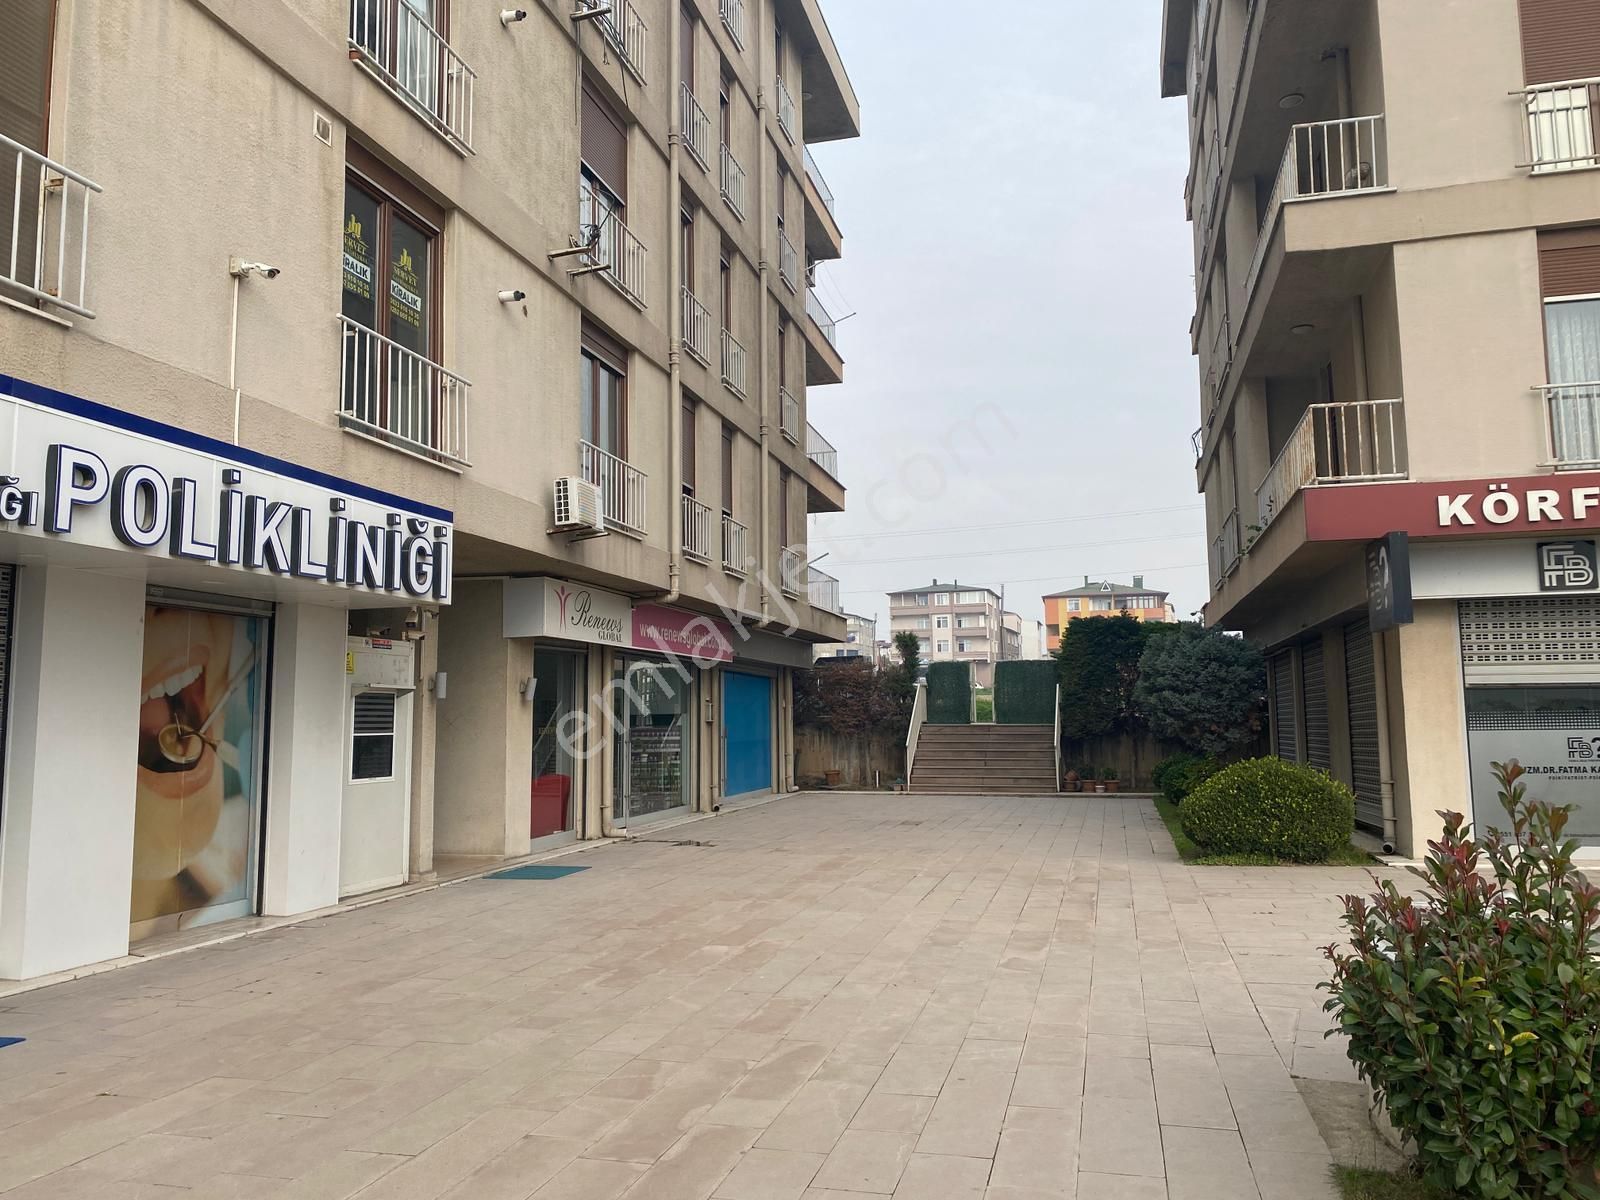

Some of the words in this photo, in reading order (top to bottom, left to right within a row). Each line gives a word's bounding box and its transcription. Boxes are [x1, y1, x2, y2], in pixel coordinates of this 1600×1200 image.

[344, 234, 367, 256] ERVET
[343, 253, 369, 279] İRALIK
[391, 283, 418, 309] KİRALIK
[1438, 483, 1600, 526] KÖRF
[44, 443, 449, 600] POLİKLİNİĞİ
[571, 591, 623, 633] Renews
[598, 631, 622, 643] GLOBAL
